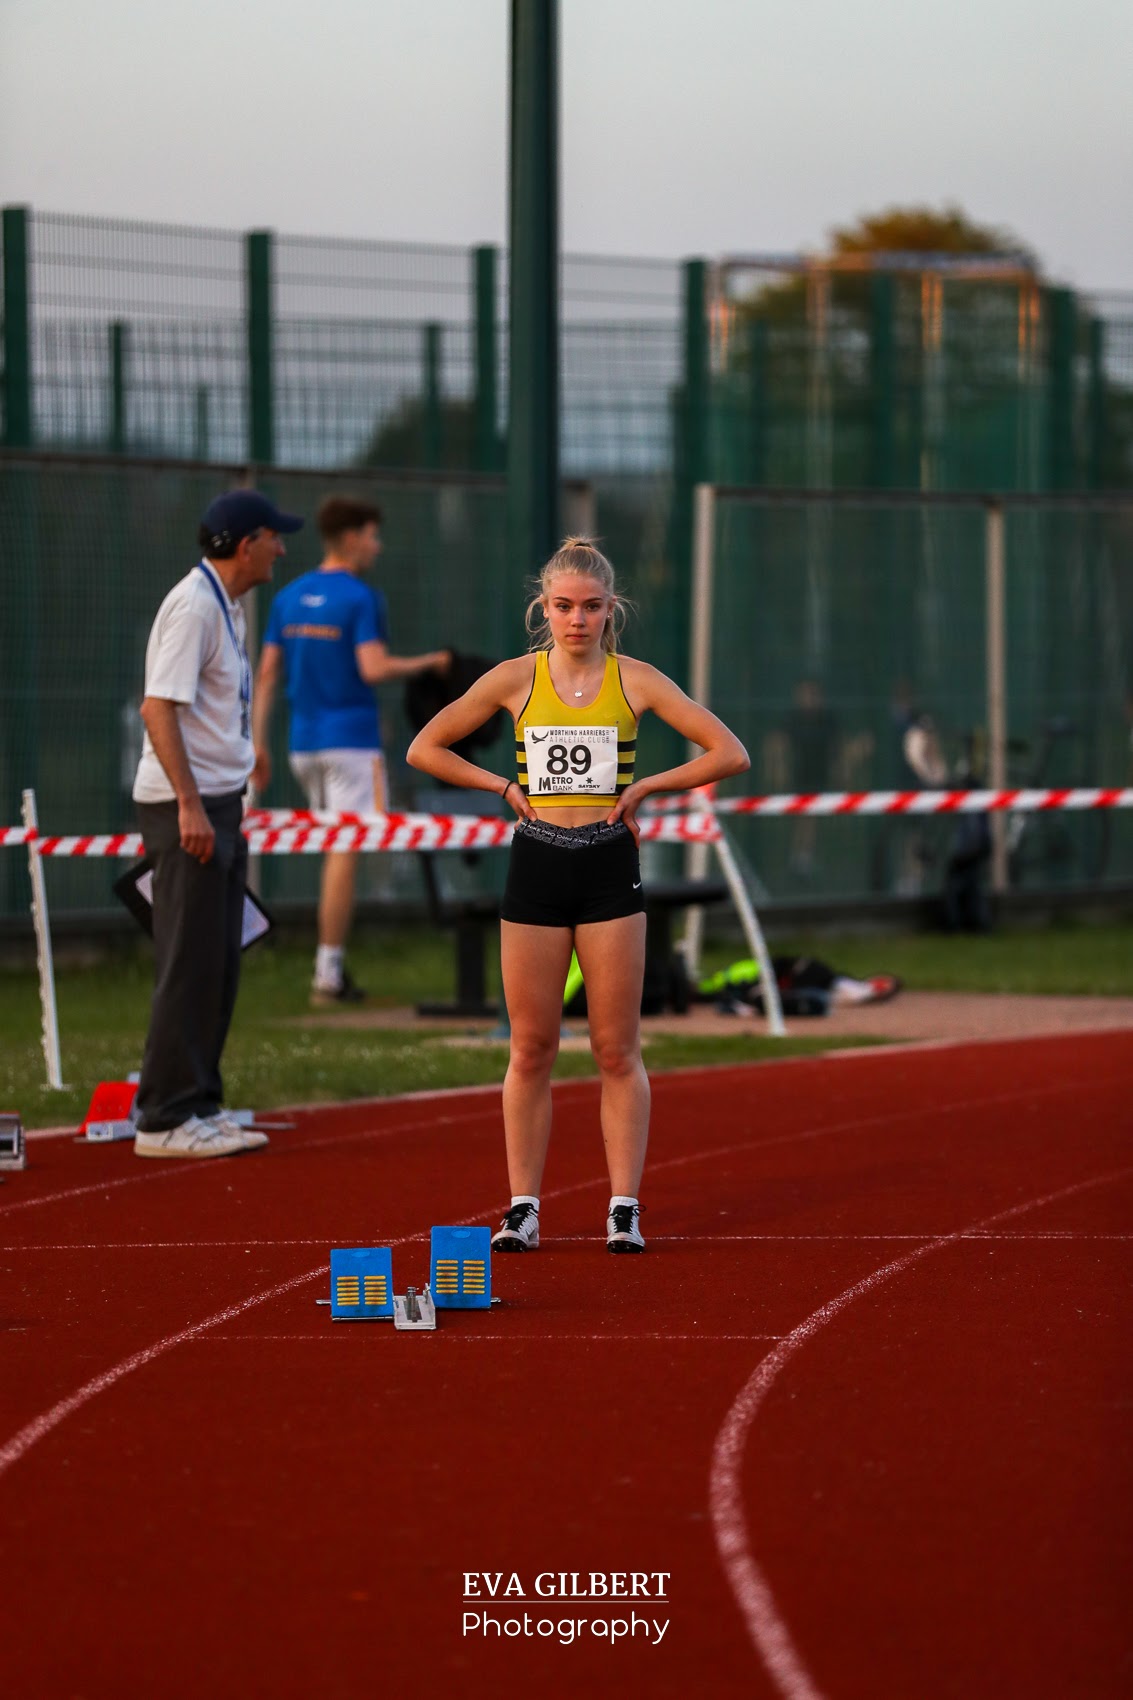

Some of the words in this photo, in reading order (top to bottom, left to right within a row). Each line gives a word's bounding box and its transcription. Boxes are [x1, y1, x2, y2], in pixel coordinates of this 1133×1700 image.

[546, 744, 592, 775] 89
[538, 776, 574, 792] METRO
[527, 825, 541, 833] NIKE
